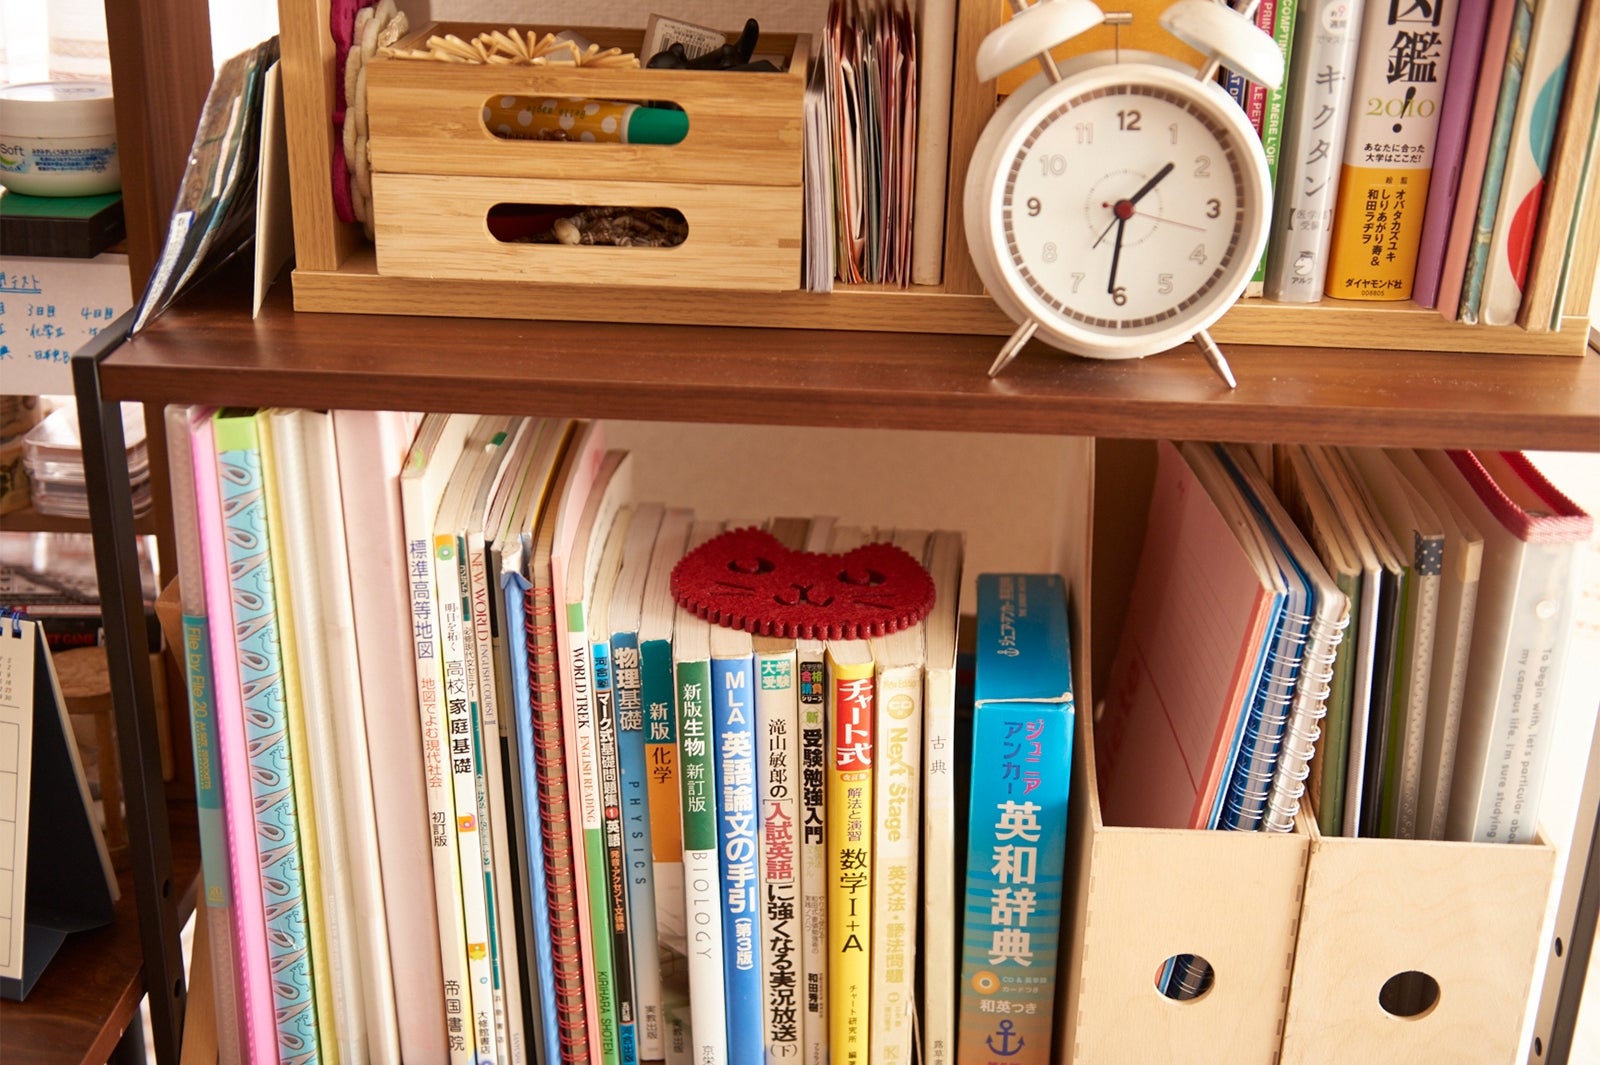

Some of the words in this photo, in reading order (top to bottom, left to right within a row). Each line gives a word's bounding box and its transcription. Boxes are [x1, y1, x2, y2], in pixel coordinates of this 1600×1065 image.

[1117, 110, 1141, 131] 12
[1268, 103, 1281, 135] MERE
[1366, 97, 1436, 117] 2010
[1075, 122, 1093, 145] 11
[1168, 122, 1178, 145] 1
[1304, 65, 1346, 197] キクタン
[1364, 143, 1425, 154] あなたに合った
[1039, 154, 1067, 176] 10
[1193, 155, 1211, 177] 2
[1365, 153, 1421, 164] 大学はここだ!
[1027, 197, 1041, 217] 9
[1206, 198, 1221, 219] 3
[1362, 189, 1379, 244] 和田ラヂヲ
[1386, 189, 1404, 263] オバタカズユキ
[1042, 242, 1057, 263] 8
[1189, 244, 1208, 265] 4
[1071, 272, 1086, 292] 7
[1112, 286, 1127, 306] 6
[1157, 273, 1174, 294] 5
[1345, 279, 1403, 289] ダイヤモンド社
[471, 552, 485, 585] NEW
[410, 539, 434, 659] 標準高等地図
[475, 587, 488, 641] WORLD
[187, 627, 199, 650] File
[1520, 648, 1529, 666] my
[1541, 648, 1552, 662] To
[188, 653, 201, 671] by
[479, 643, 491, 684] ENGLISH
[572, 646, 587, 694] WORLD
[762, 661, 791, 675] 大学
[1534, 663, 1550, 698] begin
[192, 673, 203, 697] File
[483, 684, 493, 717] COURSE
[613, 647, 642, 731] 物理基礎
[725, 671, 746, 725] MLA
[763, 675, 791, 690] 受験
[1511, 670, 1525, 714] campus
[195, 698, 208, 717] 20
[445, 660, 472, 775] 高校家庭基礎
[575, 694, 589, 729] TREK
[650, 702, 670, 740] 新版
[683, 683, 706, 758] 新版生物
[837, 679, 873, 767] チャート式
[420, 677, 442, 788] 地図でよむ現代社会
[578, 735, 593, 776] ENGLISH
[653, 747, 672, 785] 化学
[930, 736, 948, 775] 古典
[1002, 721, 1023, 794] アンカー
[1023, 719, 1044, 795] ジュニア
[686, 763, 706, 812] 新訂版
[803, 729, 824, 845] 受験勉強入門
[1499, 763, 1510, 788] sure
[1515, 760, 1530, 815] particular
[583, 777, 597, 824] READING
[847, 786, 862, 842] 解法と演習
[884, 782, 906, 842] Stage
[1486, 792, 1506, 839] studying
[432, 811, 447, 847] 初訂版
[606, 820, 621, 848] 英語
[629, 781, 647, 885] PHYSICS
[721, 730, 757, 914] 英語論文の手引
[987, 800, 1042, 967] 英和辞典
[692, 852, 712, 959] BIOLOGY
[597, 971, 611, 1014] KIRIHARA
[979, 999, 1037, 1015] 和英つき
[444, 980, 465, 1051] 帝国書院
[601, 1017, 613, 1055] SHOTEN
